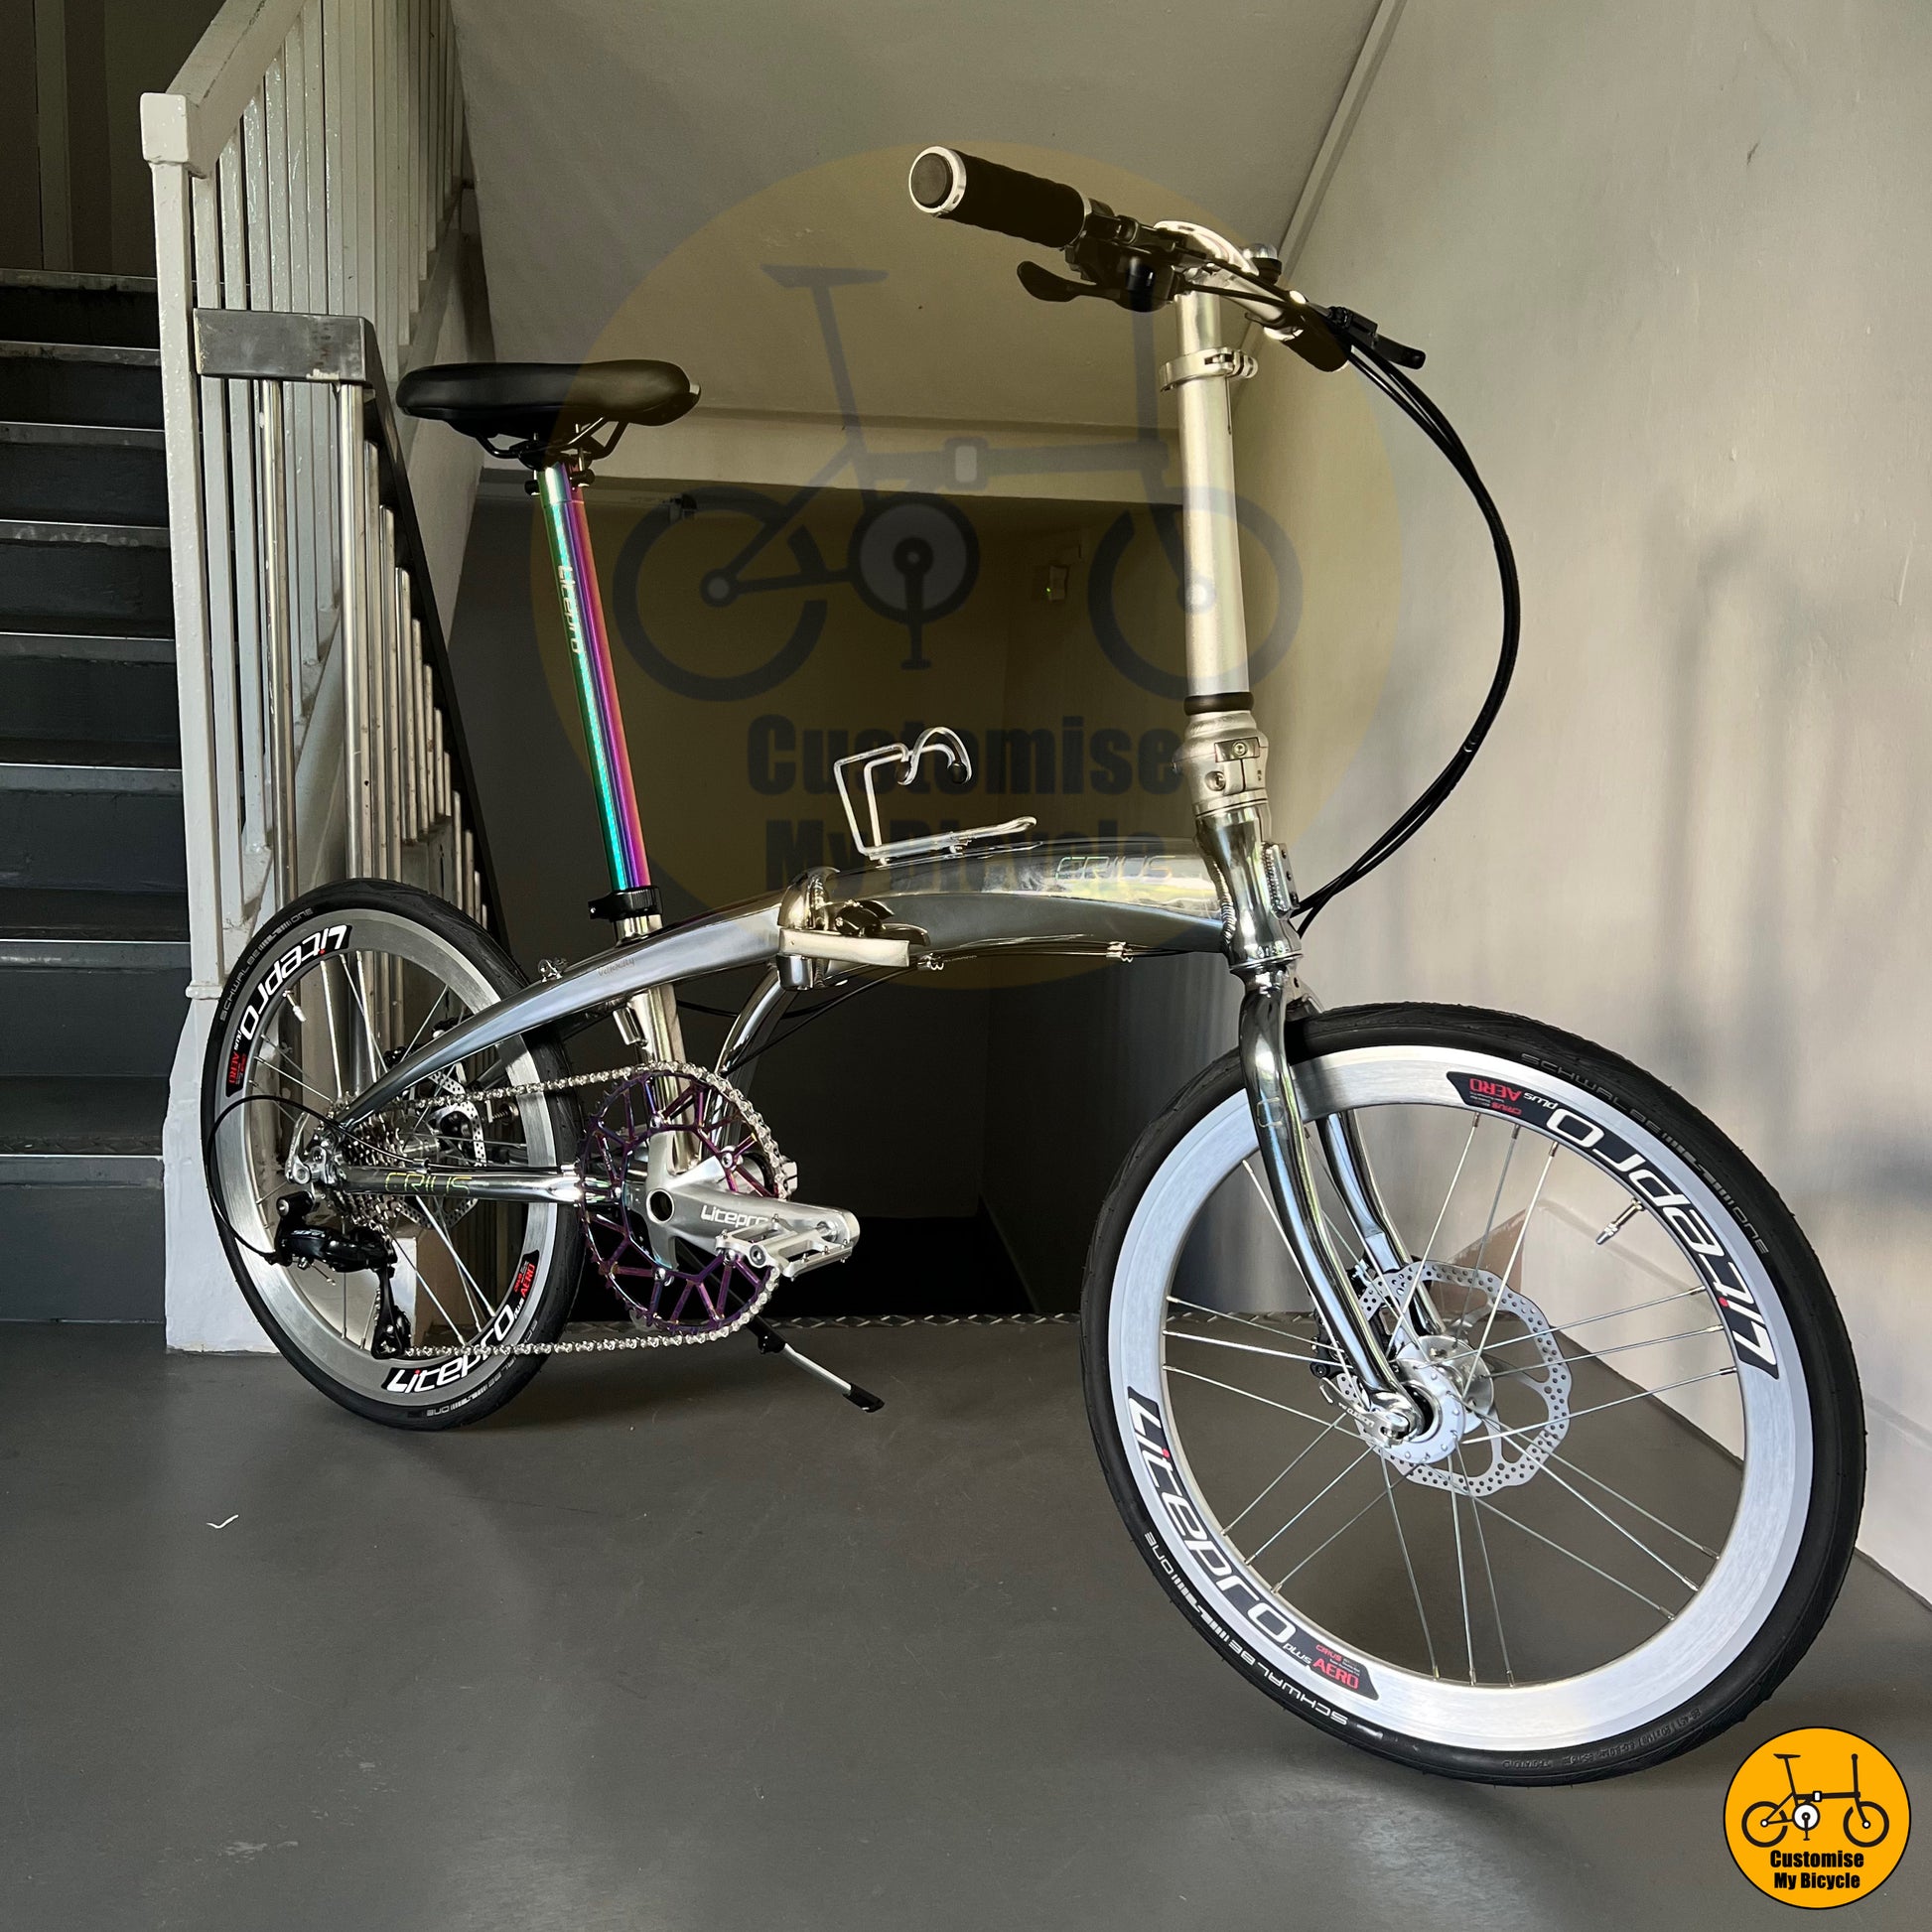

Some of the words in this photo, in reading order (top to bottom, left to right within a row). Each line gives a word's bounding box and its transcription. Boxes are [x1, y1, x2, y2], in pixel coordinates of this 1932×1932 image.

[219, 949, 261, 1022] SCHWALBE
[240, 924, 347, 1040] Litepro
[1469, 1078, 1522, 1102] AERO
[1523, 1092, 1559, 1110] plus
[1521, 1052, 1662, 1135] SCHWALBE
[1733, 1206, 1769, 1254] ONE
[1546, 1108, 1777, 1365] Litepro
[1128, 1397, 1297, 1643] Litepro
[1283, 1642, 1312, 1665] plus
[1312, 1657, 1359, 1690] AERO
[1144, 1532, 1174, 1575] ONE
[1228, 1638, 1348, 1725] SCHWALBE
